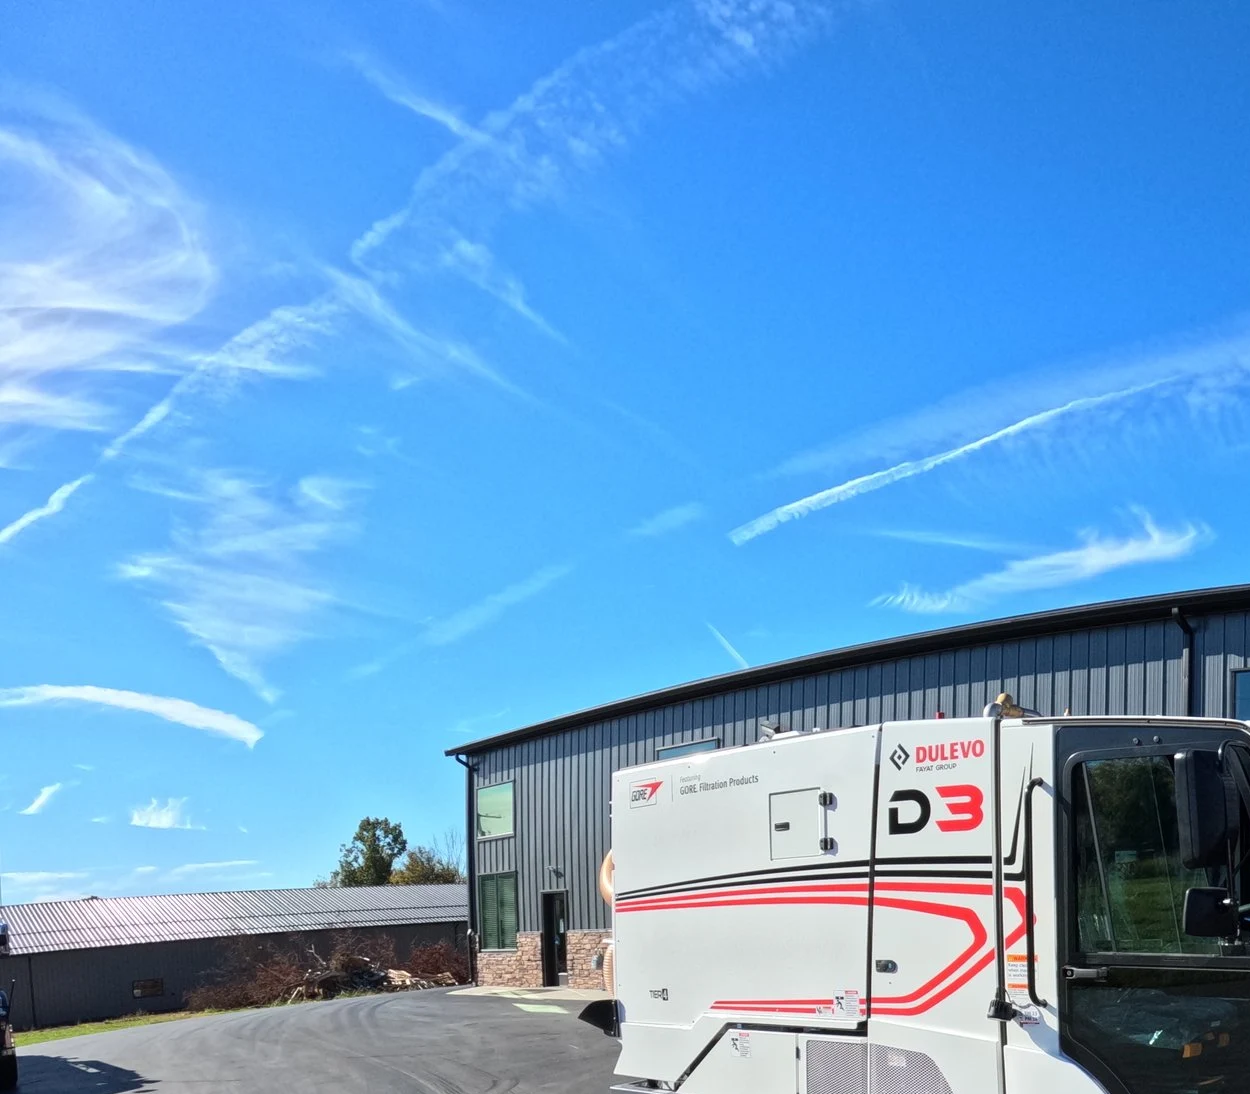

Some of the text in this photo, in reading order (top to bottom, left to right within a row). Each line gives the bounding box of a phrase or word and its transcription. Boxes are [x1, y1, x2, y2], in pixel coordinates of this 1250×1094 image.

[915, 739, 985, 764] DULEVO
[915, 763, 958, 773] FAYAT GROUP
[699, 780, 728, 792] Filtration
[729, 774, 759, 787] Products
[631, 788, 648, 802] GORE
[888, 784, 984, 836] D3
